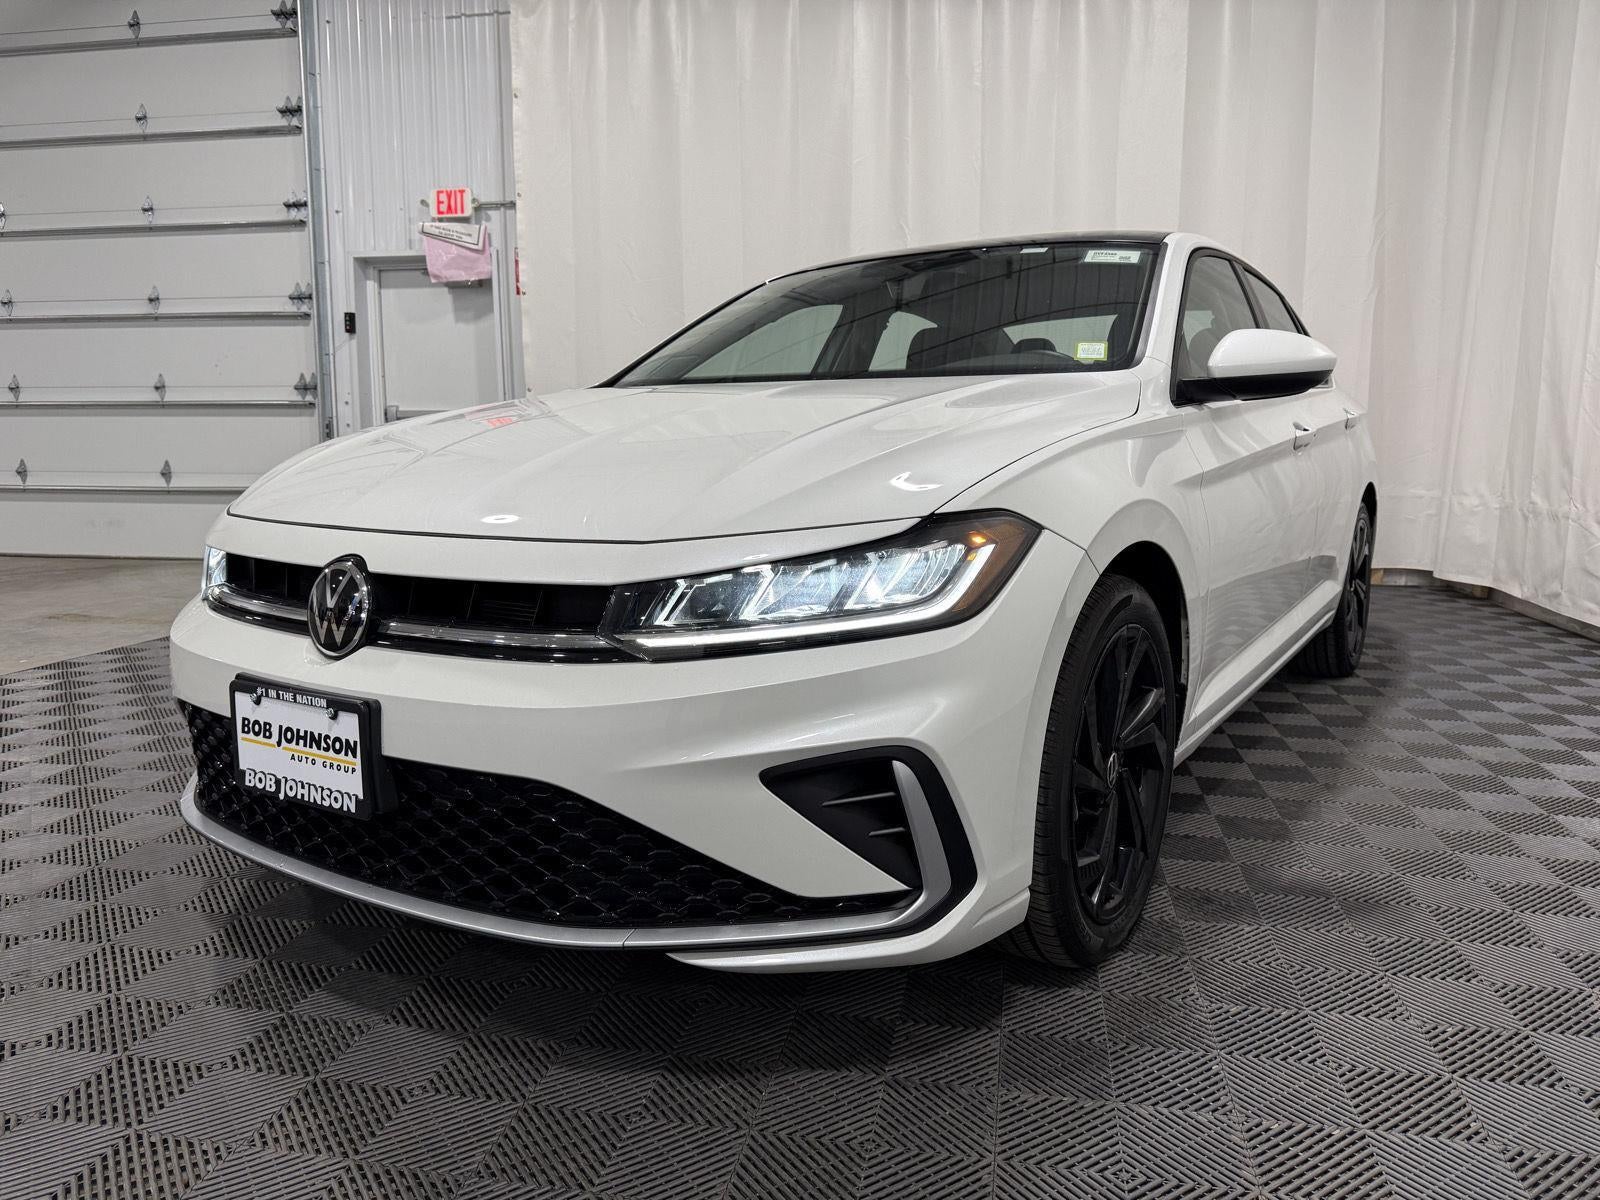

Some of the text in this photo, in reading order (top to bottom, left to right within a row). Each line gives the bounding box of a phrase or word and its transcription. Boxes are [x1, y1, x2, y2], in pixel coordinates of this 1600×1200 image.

[436, 189, 465, 215] EXIT
[256, 686, 327, 708] #1 IN THE NATION
[241, 716, 358, 759] BOB JOHNSON
[290, 753, 357, 775] AUTO GROUP
[245, 768, 358, 813] BOB JOHNSON
